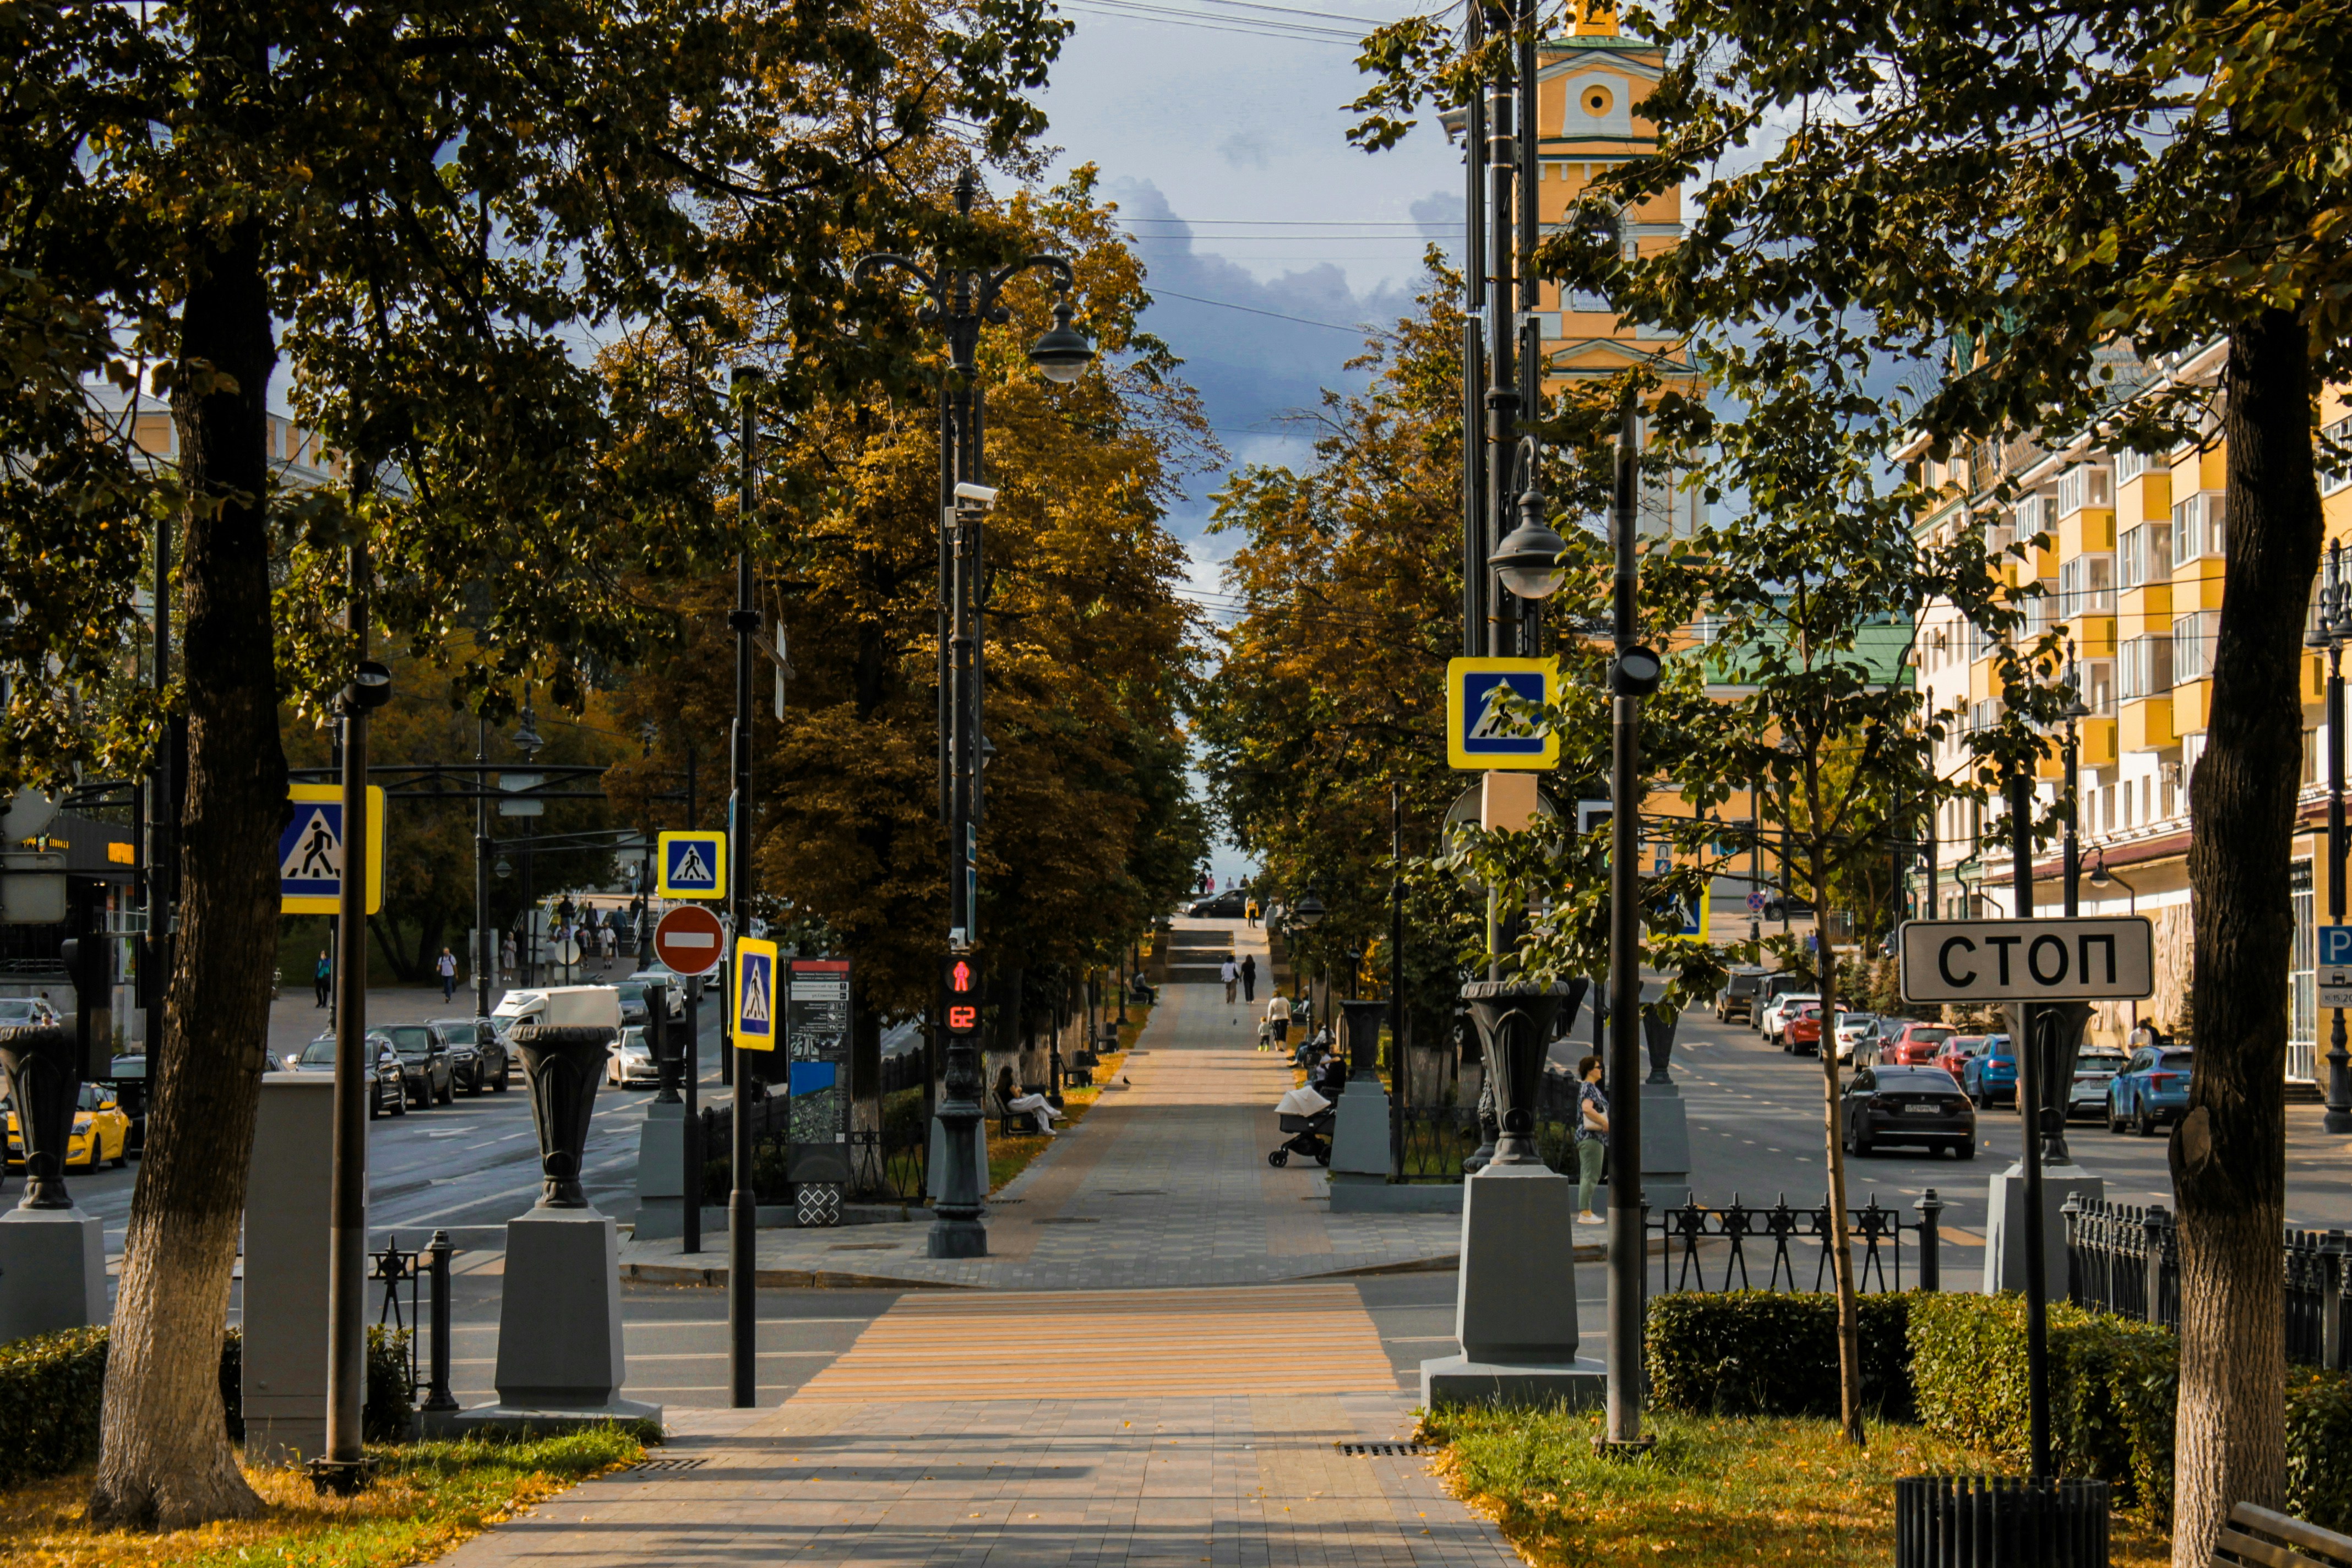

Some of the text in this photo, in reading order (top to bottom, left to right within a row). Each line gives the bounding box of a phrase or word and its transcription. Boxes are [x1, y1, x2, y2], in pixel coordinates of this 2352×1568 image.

[1939, 934, 2116, 988] СТОП
[2329, 930, 2351, 961] P
[950, 1006, 975, 1028] 62
